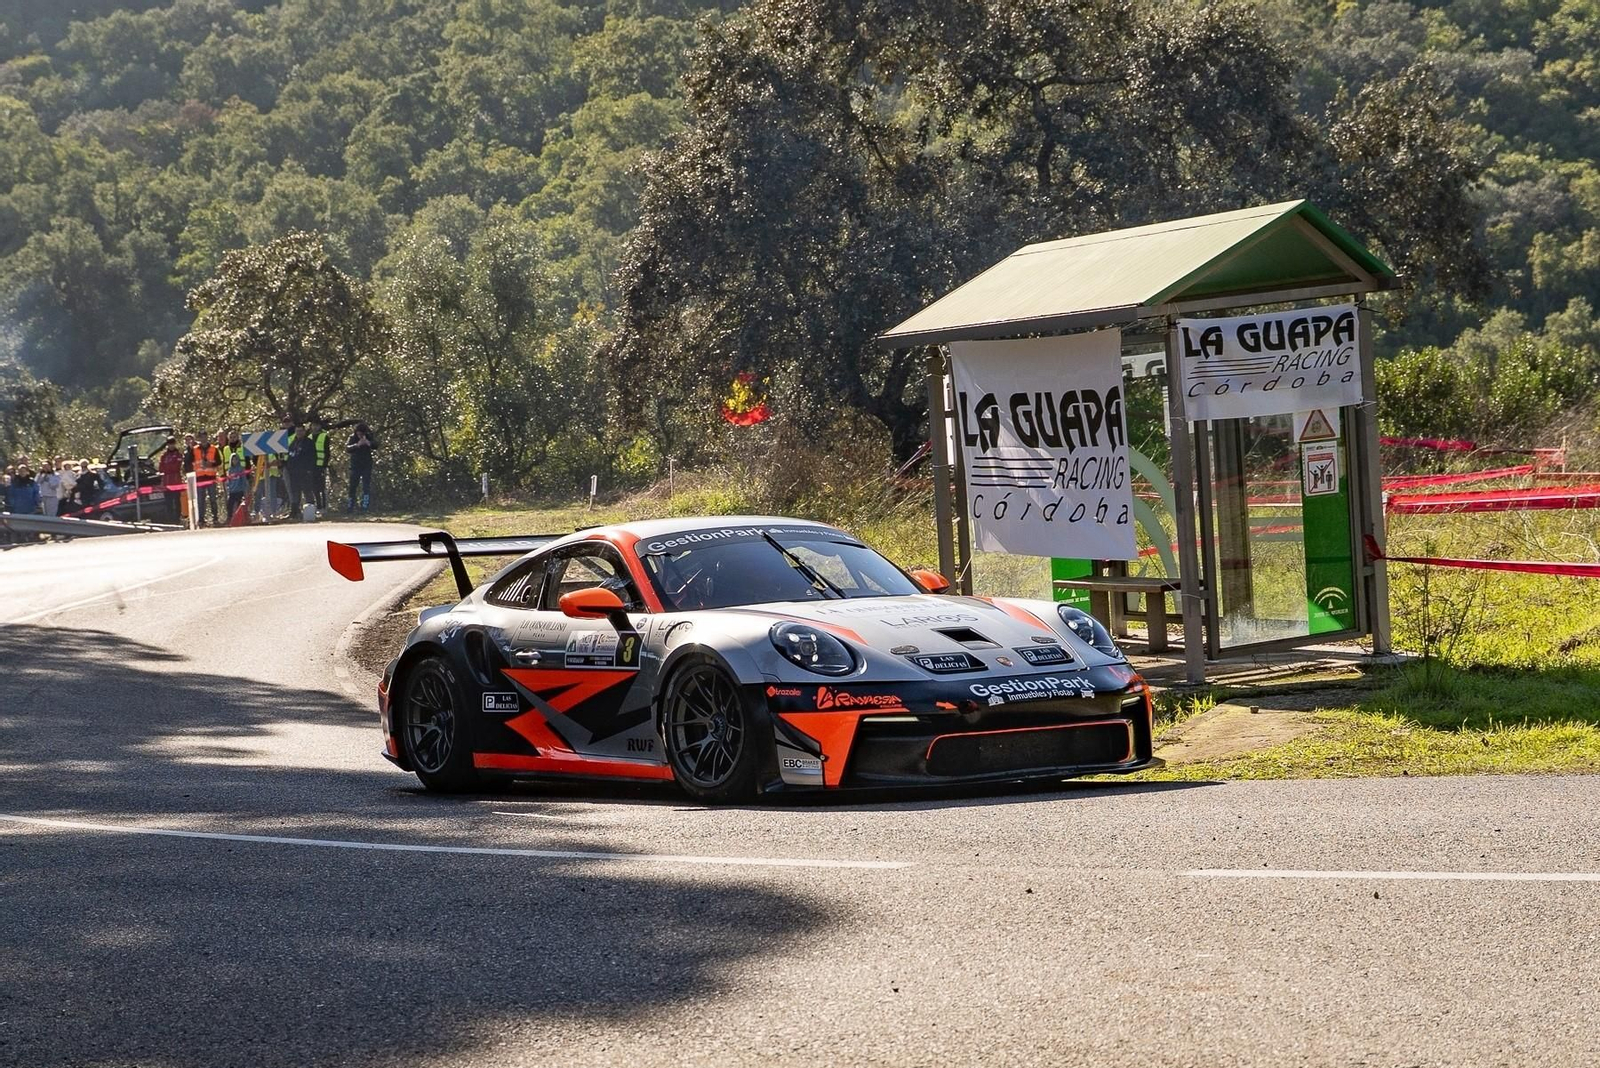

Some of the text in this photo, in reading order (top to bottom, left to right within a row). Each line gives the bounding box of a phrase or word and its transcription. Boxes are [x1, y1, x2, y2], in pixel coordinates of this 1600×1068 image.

[1181, 311, 1356, 360] LA GUAPA
[1271, 346, 1354, 374] RACING
[1187, 370, 1354, 398] Córdoba
[958, 385, 1125, 455] LA GUAPA
[1052, 456, 1125, 490] RACING
[973, 492, 1129, 525] Córdoba
[647, 526, 764, 552] GestionPark
[623, 636, 635, 663] 3
[1037, 653, 1063, 661] DELICIAS
[969, 676, 1096, 697] GestionPark
[1007, 690, 1047, 701] Inmuebles
[1052, 688, 1075, 698] Flotas
[783, 759, 802, 769] EBC
